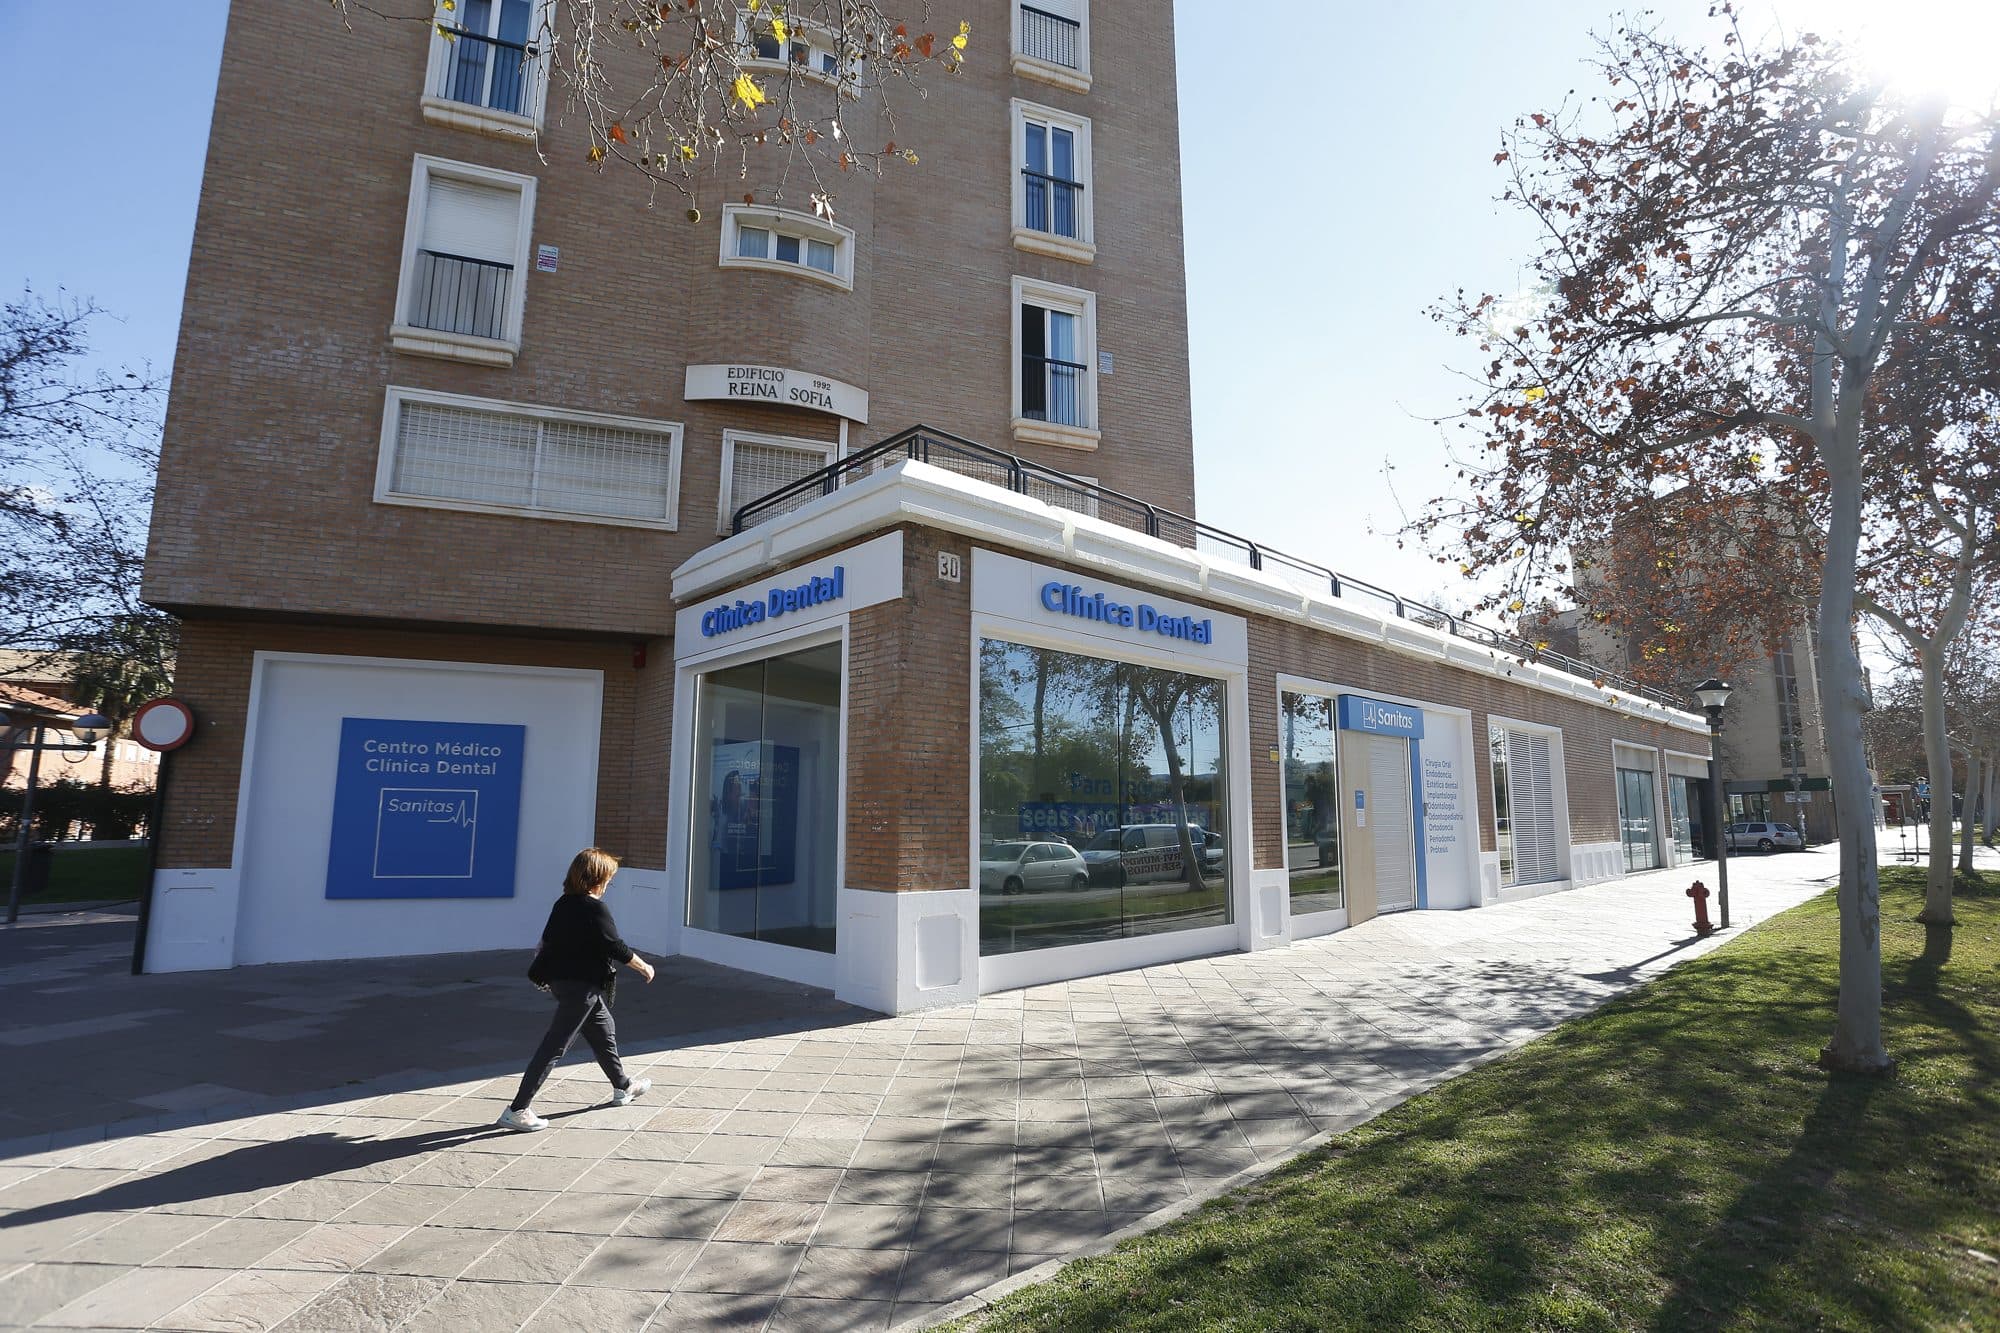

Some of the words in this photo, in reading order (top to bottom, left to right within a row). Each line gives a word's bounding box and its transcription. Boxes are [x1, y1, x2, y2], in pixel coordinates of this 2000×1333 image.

[727, 367, 785, 382] EDIFICIO
[728, 382, 778, 399] REINA
[813, 379, 832, 391] 1992
[940, 554, 958, 579] 30
[701, 600, 765, 638] Clínica
[767, 566, 844, 618] Dental
[1041, 581, 1135, 627] Clínica
[1138, 604, 1212, 645] Dental
[1377, 707, 1413, 729] Sanitas
[363, 739, 429, 755] Centro
[435, 742, 502, 757] Médico
[366, 758, 430, 773] Clínica
[436, 760, 497, 775] Dental
[1425, 770, 1452, 779] Endodoncia
[1071, 773, 1112, 796] Para
[388, 798, 454, 813] Sanitas
[1022, 808, 1070, 827] seas
[1150, 805, 1208, 826] Sanas
